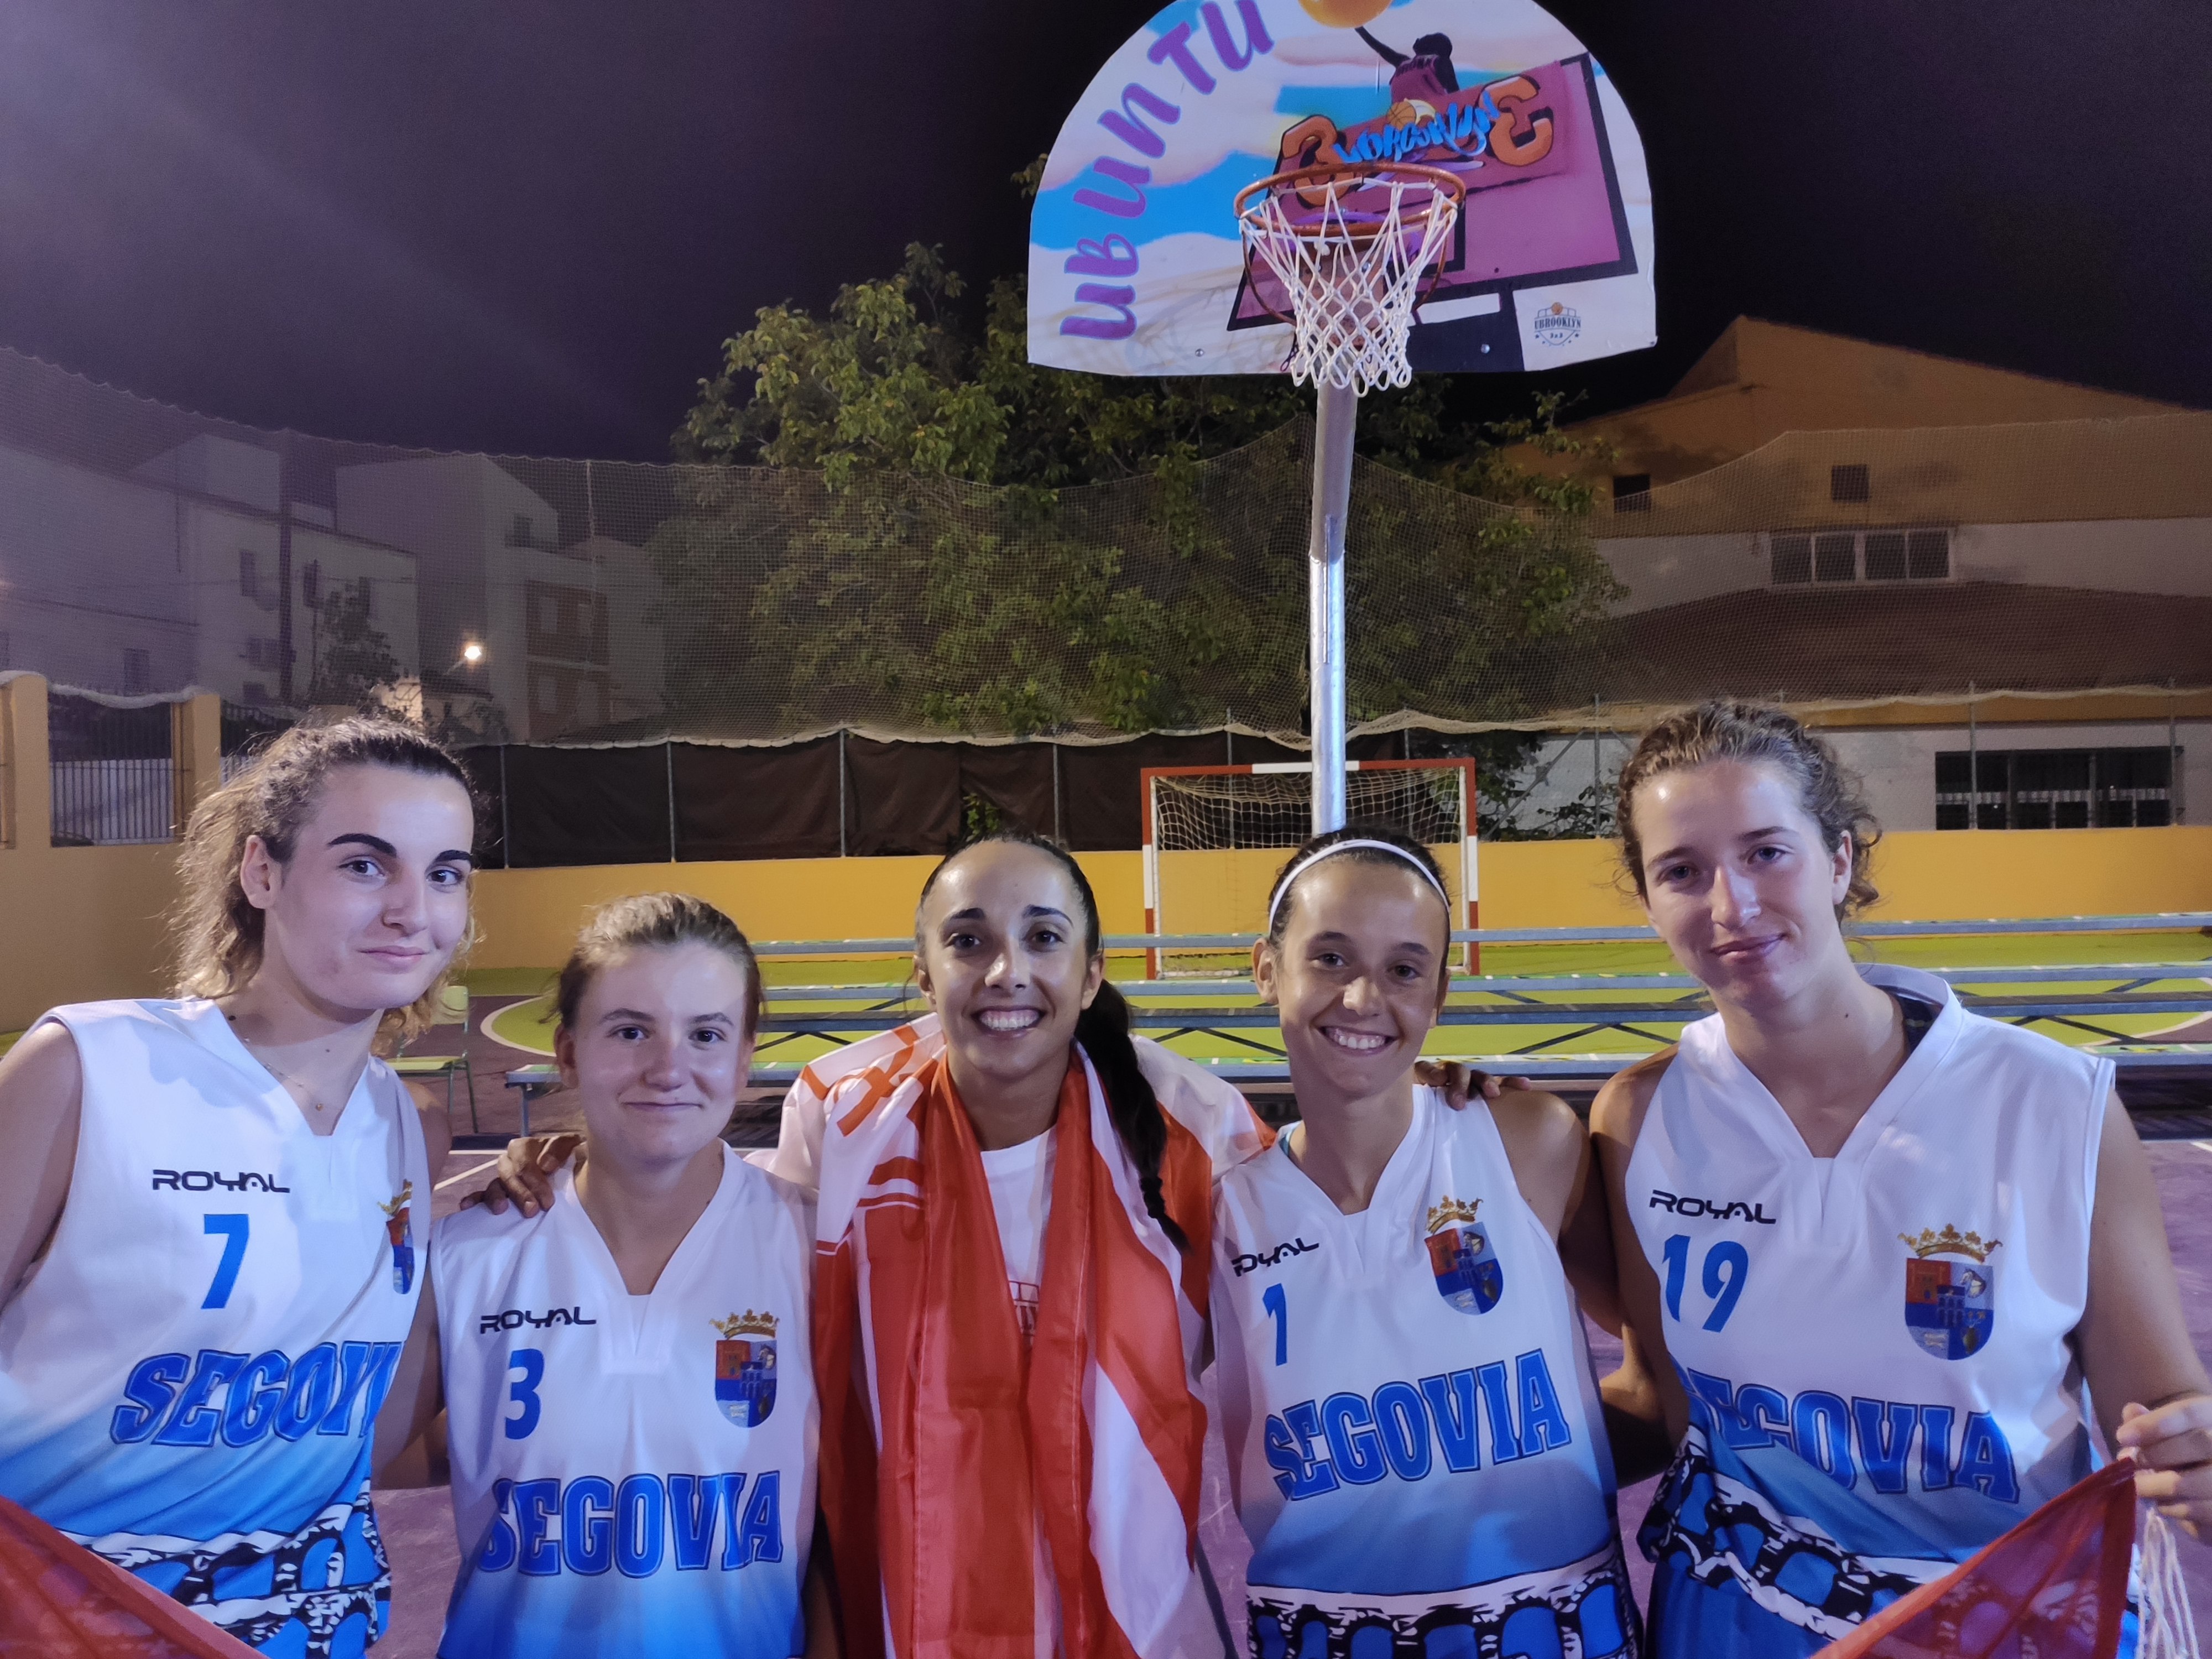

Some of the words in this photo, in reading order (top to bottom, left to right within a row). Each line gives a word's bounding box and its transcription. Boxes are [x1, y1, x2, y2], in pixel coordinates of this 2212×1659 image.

[1060, 0, 1274, 341] UBUNTU
[1535, 317, 1581, 330] UBROOKLYN
[152, 1169, 290, 1193] ROYAL
[1649, 1189, 1776, 1224] ROYAL
[201, 1213, 249, 1310] 7
[1661, 1234, 1749, 1333] 19
[480, 1306, 596, 1334] ROYAL
[1262, 1283, 1288, 1366] 1
[505, 1348, 545, 1439] 3
[1264, 1348, 1572, 1501] SEGOVIA
